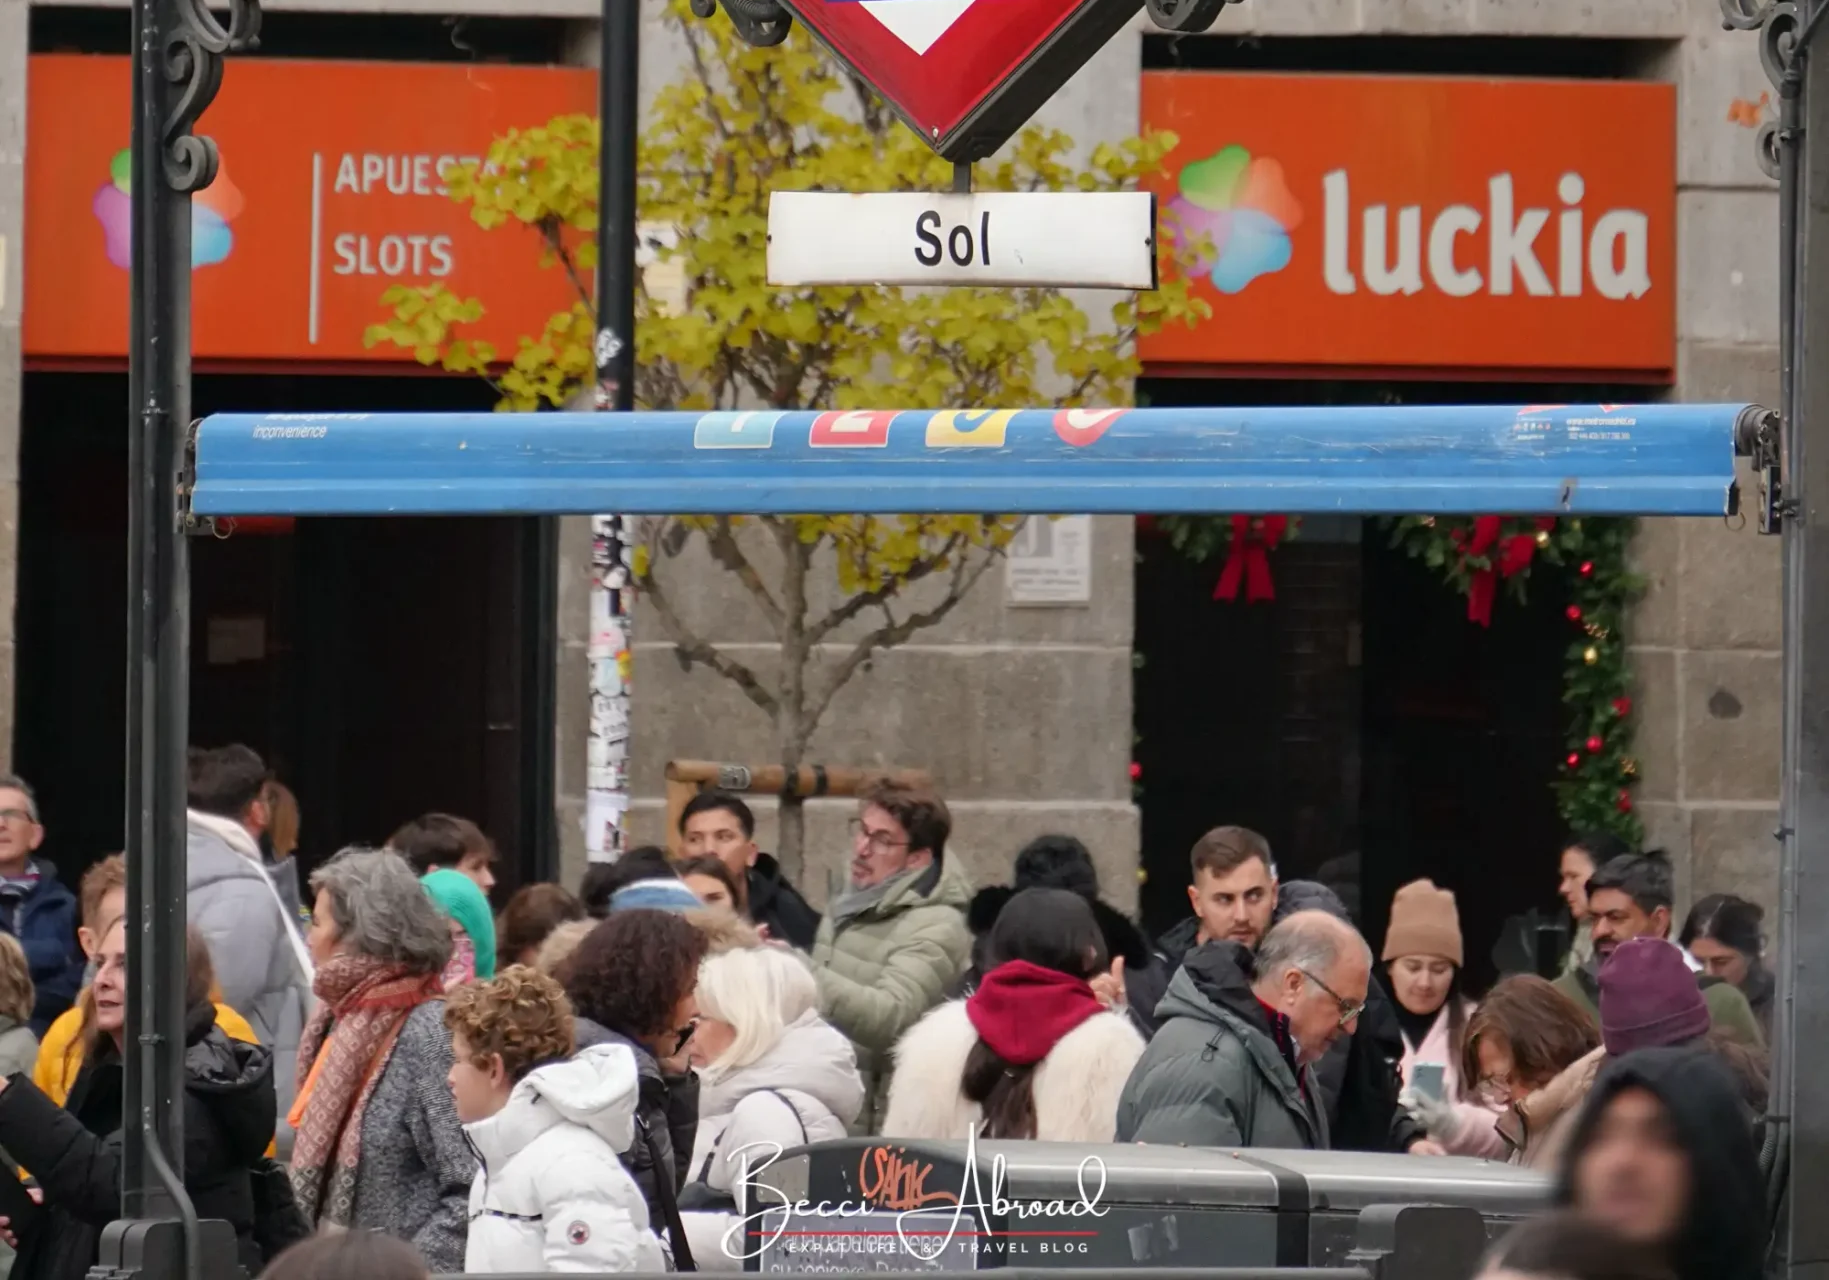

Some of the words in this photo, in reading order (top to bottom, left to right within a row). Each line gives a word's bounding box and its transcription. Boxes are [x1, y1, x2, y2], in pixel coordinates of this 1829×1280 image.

[333, 233, 454, 276] SLOTS
[914, 209, 992, 267] Sol
[1321, 168, 1652, 300] luckia
[252, 424, 327, 439] inconvenience
